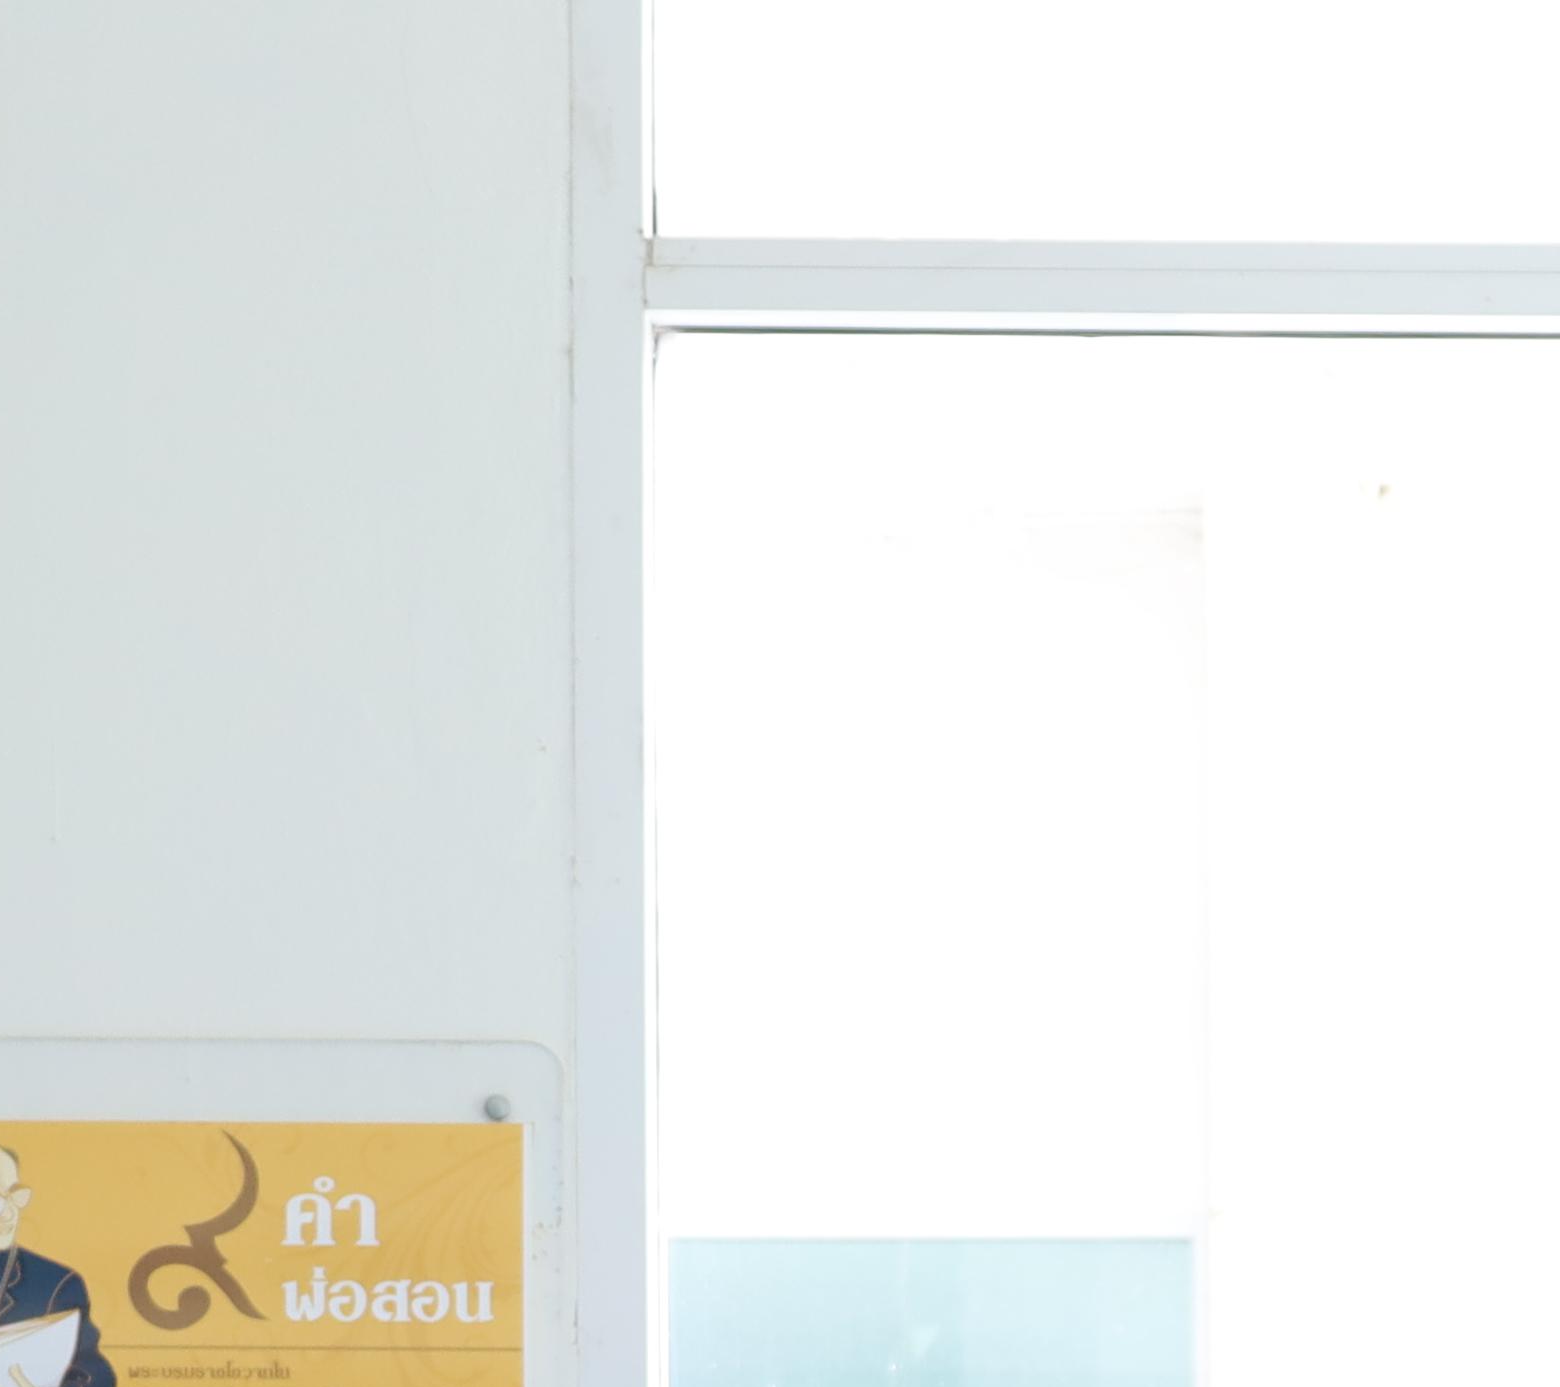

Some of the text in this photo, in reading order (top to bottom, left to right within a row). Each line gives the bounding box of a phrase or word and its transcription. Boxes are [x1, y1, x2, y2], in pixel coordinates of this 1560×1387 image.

[129, 1130, 380, 1331] ๙ คำ
[282, 1266, 495, 1323] พ่อสอน
